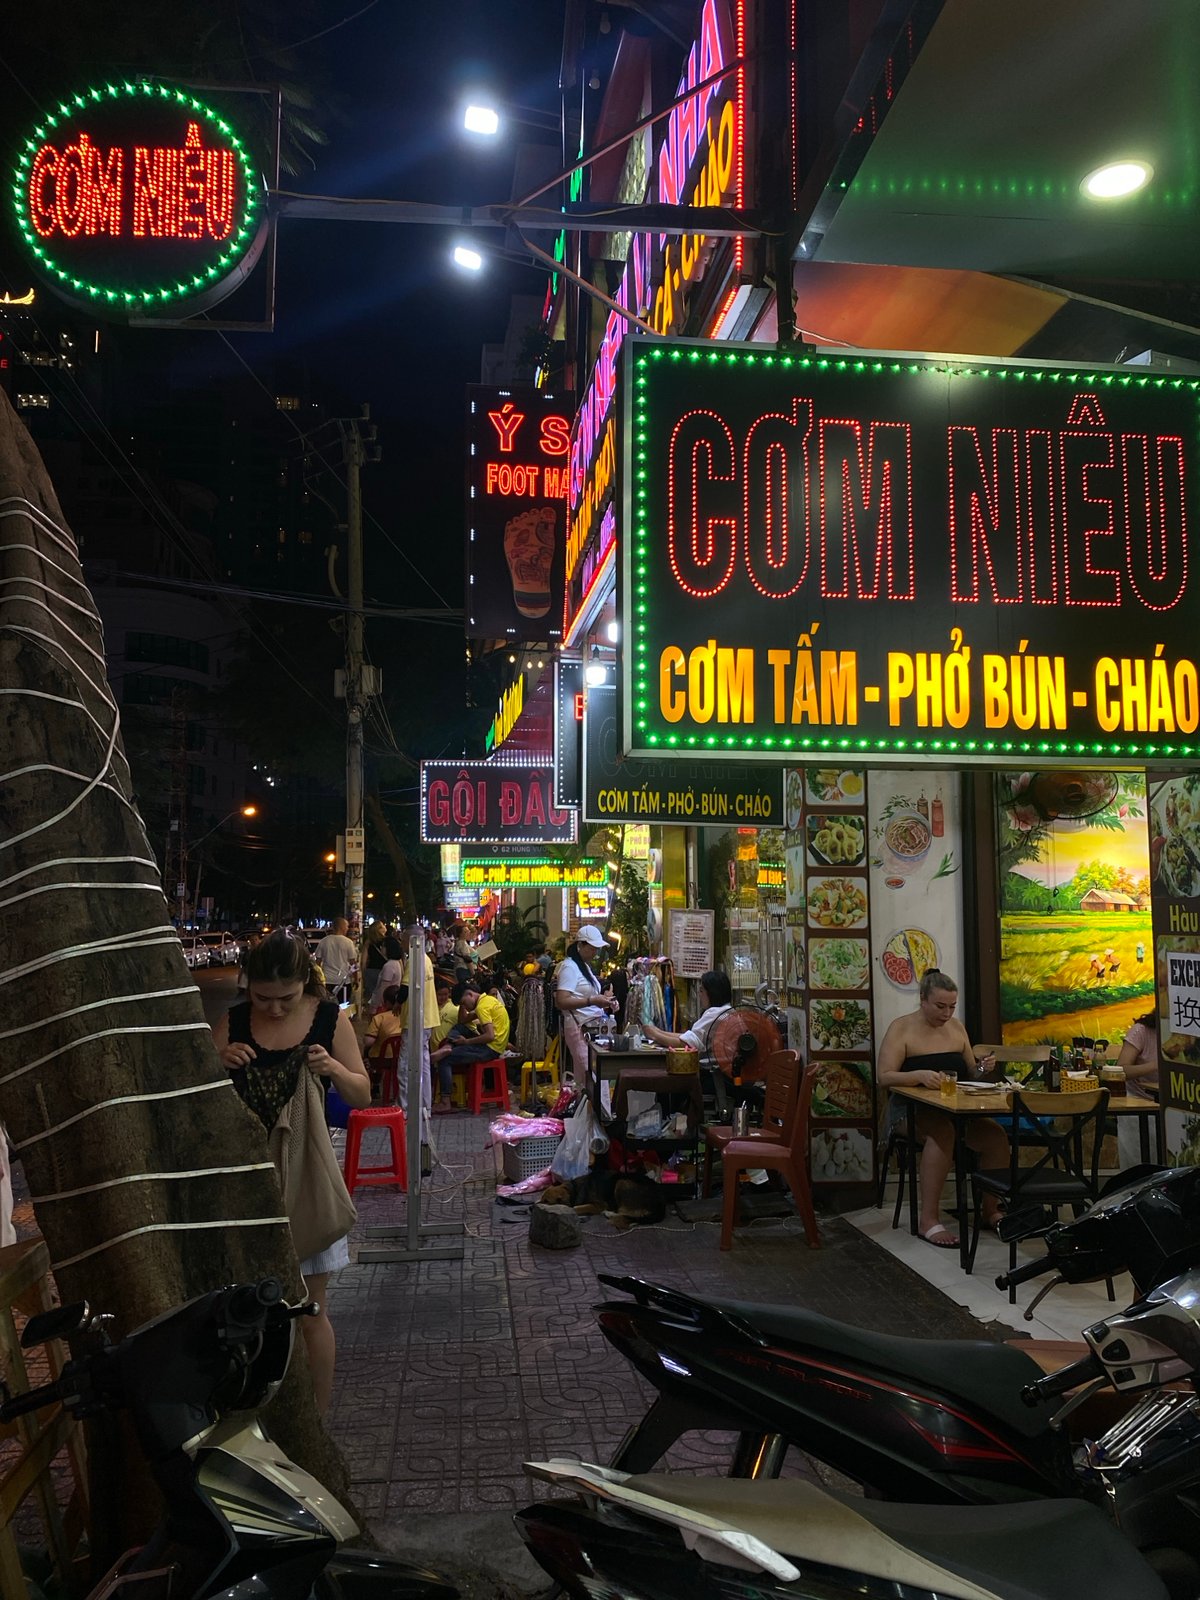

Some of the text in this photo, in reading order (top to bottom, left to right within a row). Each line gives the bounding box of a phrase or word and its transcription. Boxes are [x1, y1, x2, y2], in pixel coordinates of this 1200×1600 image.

[29, 133, 125, 237] CƠM
[488, 404, 524, 452] Ý
[487, 463, 539, 497] FOOT
[667, 397, 916, 601] CƠM
[947, 394, 1188, 611] NIÊU
[660, 639, 755, 724] CƠM
[767, 622, 858, 726] TẤM
[888, 627, 970, 729] PHỞ
[982, 639, 1067, 731] BÚN
[1094, 643, 1200, 734] CHÁO
[428, 769, 488, 837] GỘI
[597, 787, 629, 813] CƠM
[631, 780, 660, 814] TẤM
[667, 785, 695, 815] PHỞ
[701, 787, 728, 816] BÚN
[735, 788, 772, 818] CHÁO
[589, 898, 606, 909] Spa
[1169, 904, 1199, 933] Hàu
